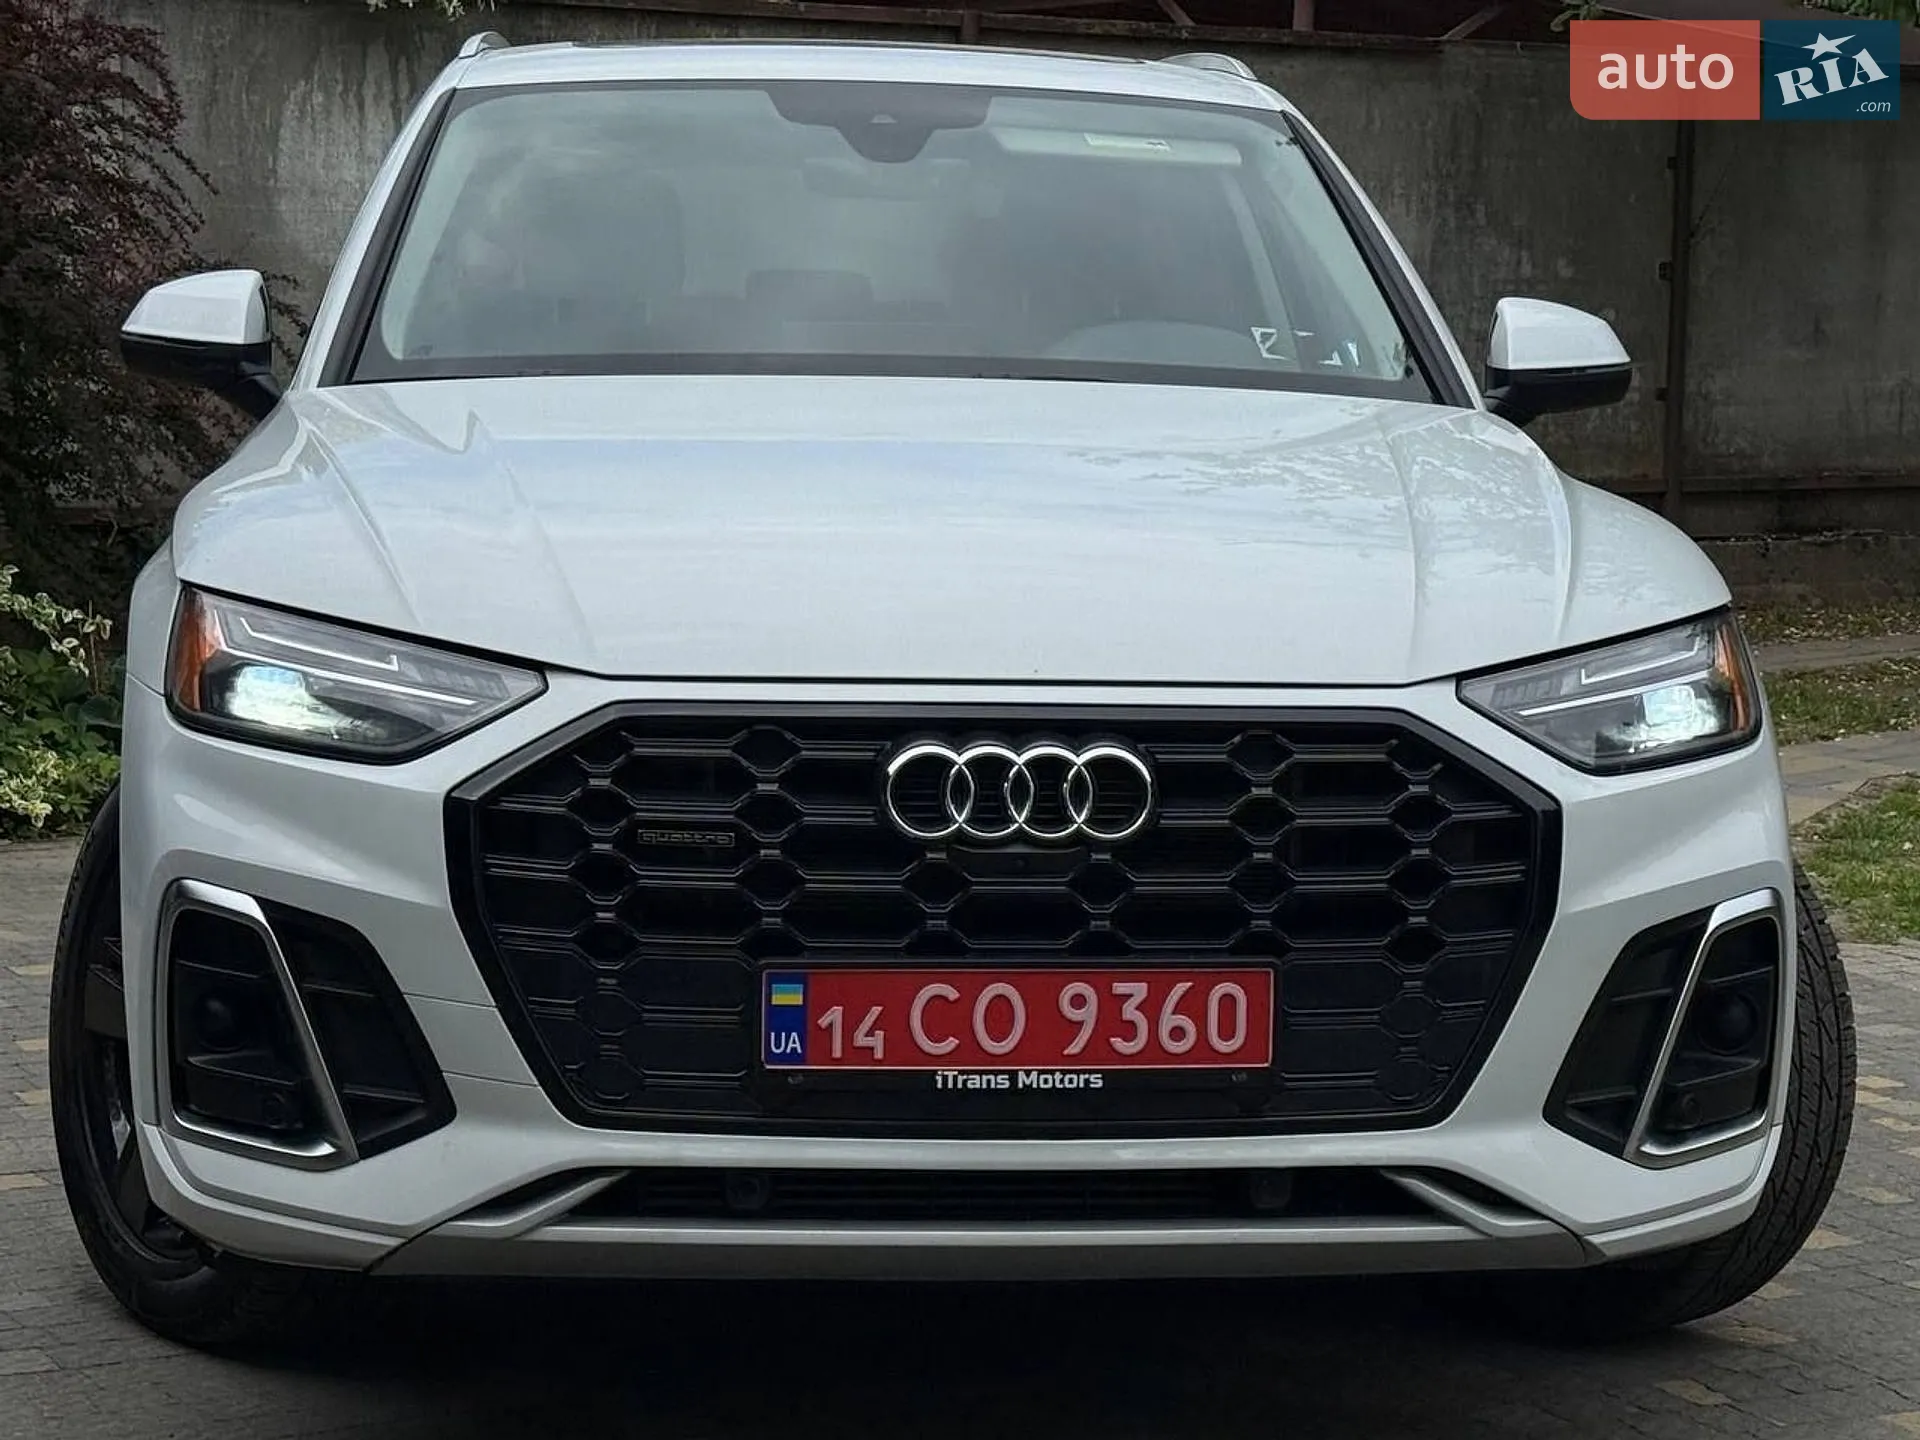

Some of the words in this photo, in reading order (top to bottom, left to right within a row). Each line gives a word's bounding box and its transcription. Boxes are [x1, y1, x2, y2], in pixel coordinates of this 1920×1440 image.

[817, 1006, 885, 1060] 14
[909, 982, 1027, 1056] CO
[1058, 982, 1249, 1056] 9360
[770, 1031, 802, 1054] UA
[935, 1070, 1011, 1089] iTrans
[1017, 1070, 1104, 1089] Motors
